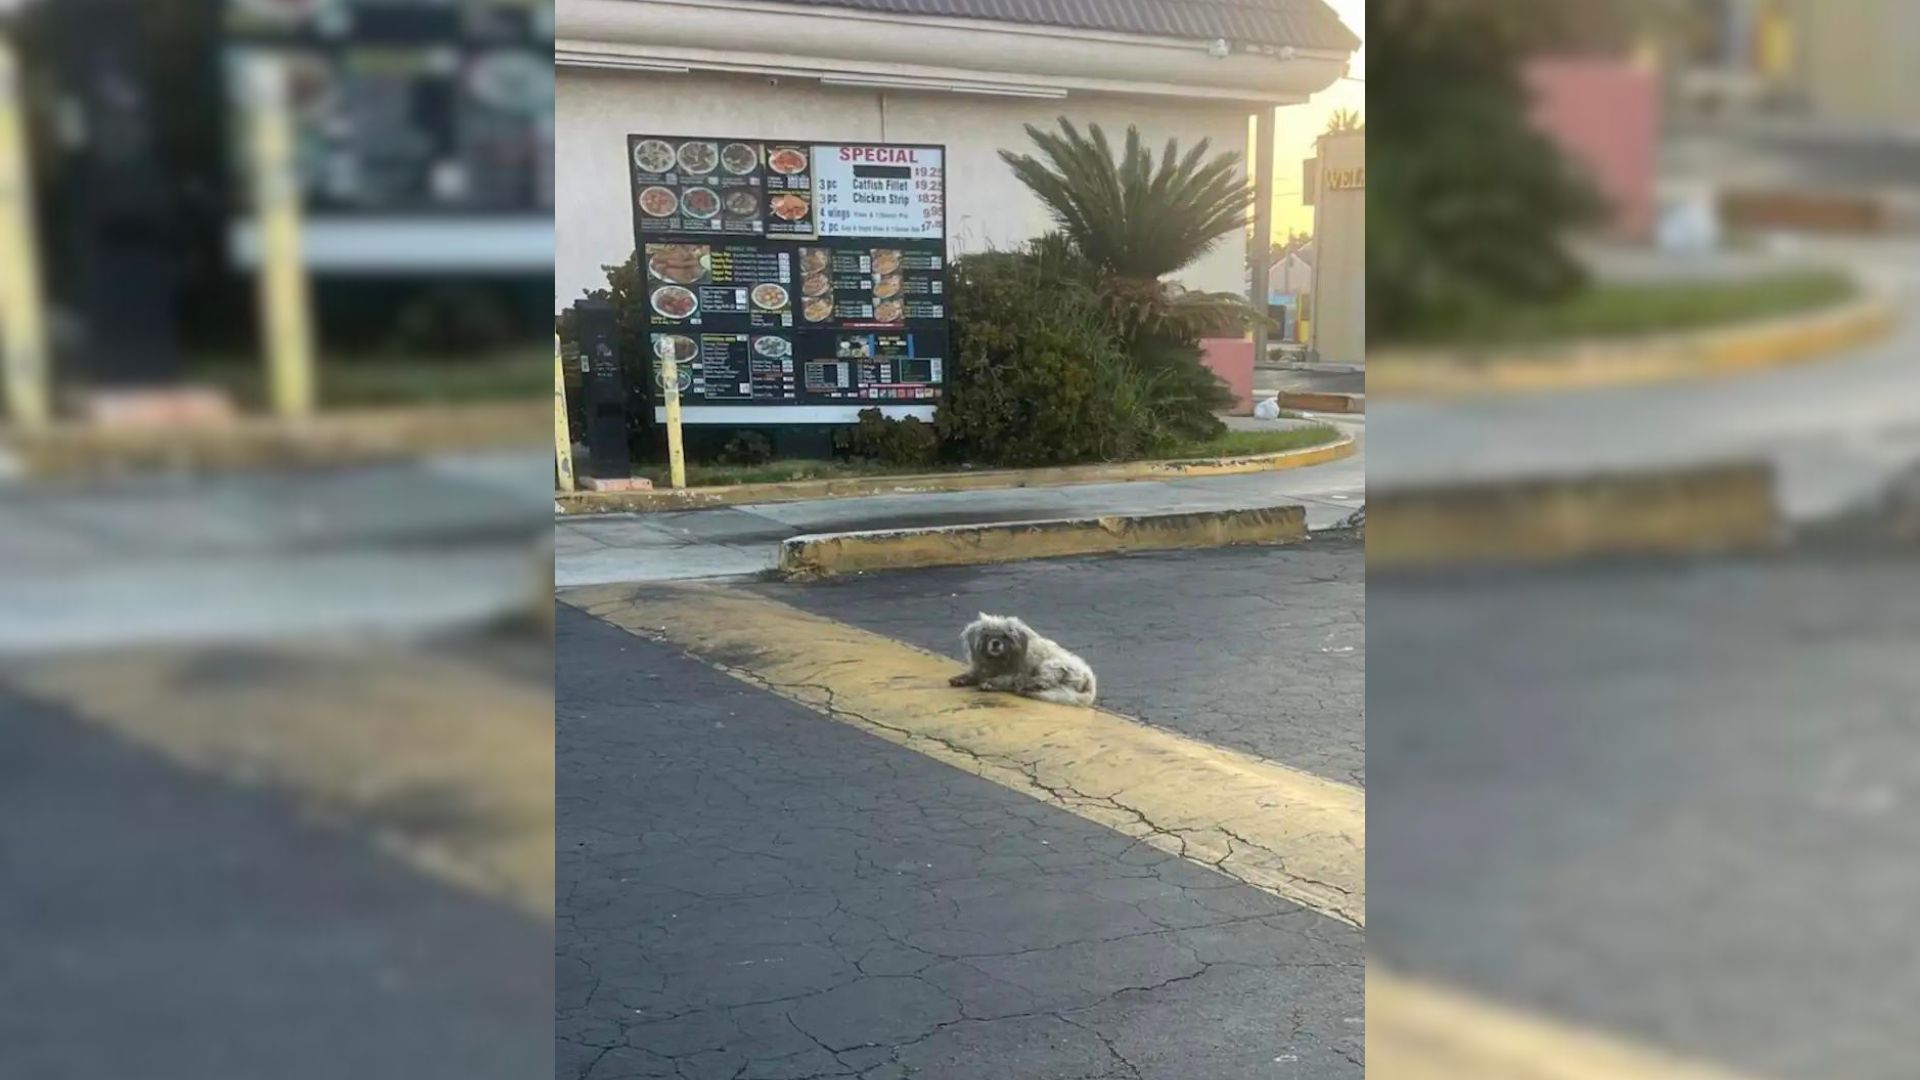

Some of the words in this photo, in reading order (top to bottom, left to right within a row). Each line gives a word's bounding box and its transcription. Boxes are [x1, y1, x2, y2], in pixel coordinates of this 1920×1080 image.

[839, 147, 919, 163] SPECIAL
[819, 179, 826, 190] 3
[827, 180, 838, 191] pc
[852, 179, 884, 191] Catfish
[886, 180, 908, 191] Fillet
[827, 193, 838, 204] pc
[852, 193, 886, 204] Chicken
[889, 194, 910, 207] Strip
[827, 208, 850, 221] wings
[820, 221, 826, 232] 2
[828, 223, 839, 233] pc
